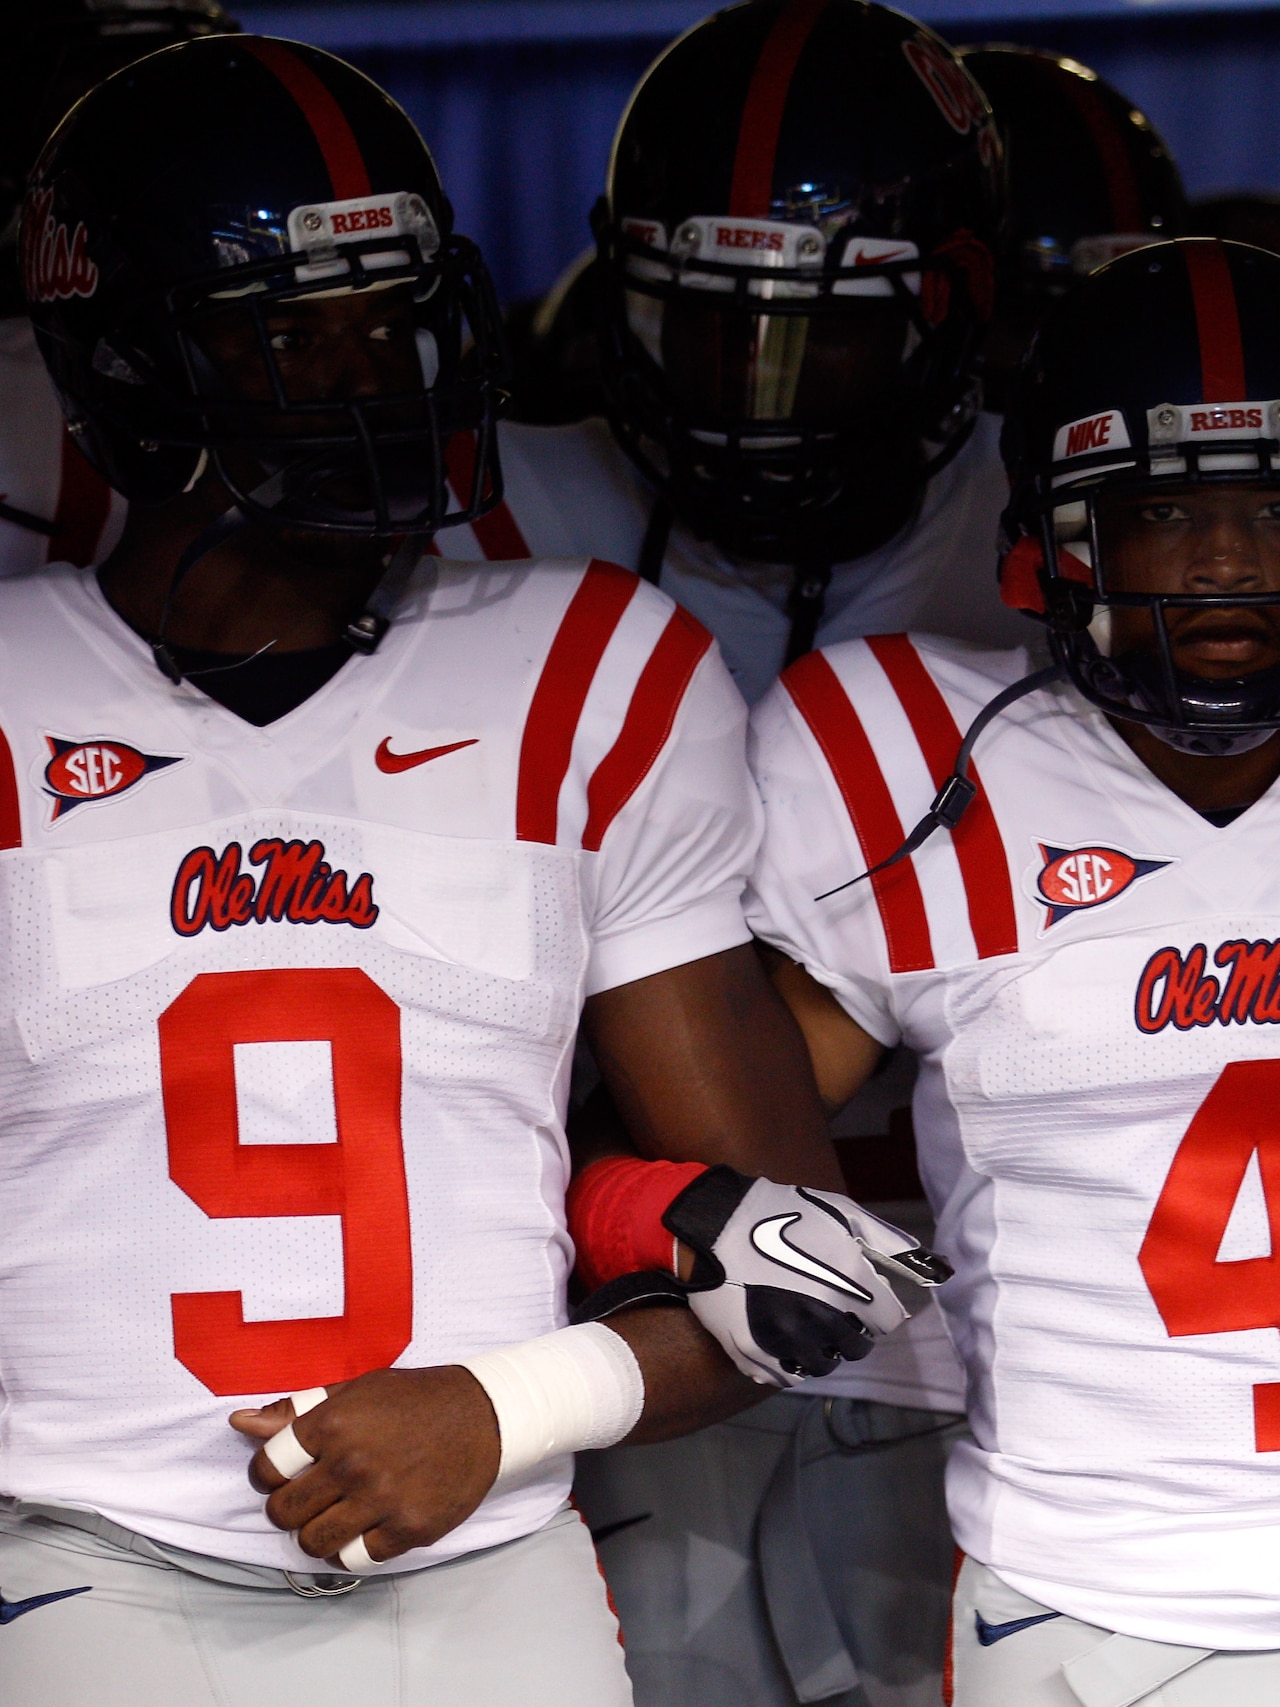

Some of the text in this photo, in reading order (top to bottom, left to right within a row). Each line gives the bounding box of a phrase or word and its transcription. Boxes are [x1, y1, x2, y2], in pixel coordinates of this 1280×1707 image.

[330, 207, 393, 235] REBS
[1066, 414, 1113, 457] NIKE
[1190, 408, 1263, 432] REBS
[64, 746, 124, 795] SEC
[170, 837, 379, 937] Ole Miss
[1056, 853, 1114, 902] SEC
[1134, 943, 1220, 1034] Ole
[158, 967, 413, 1397] 9
